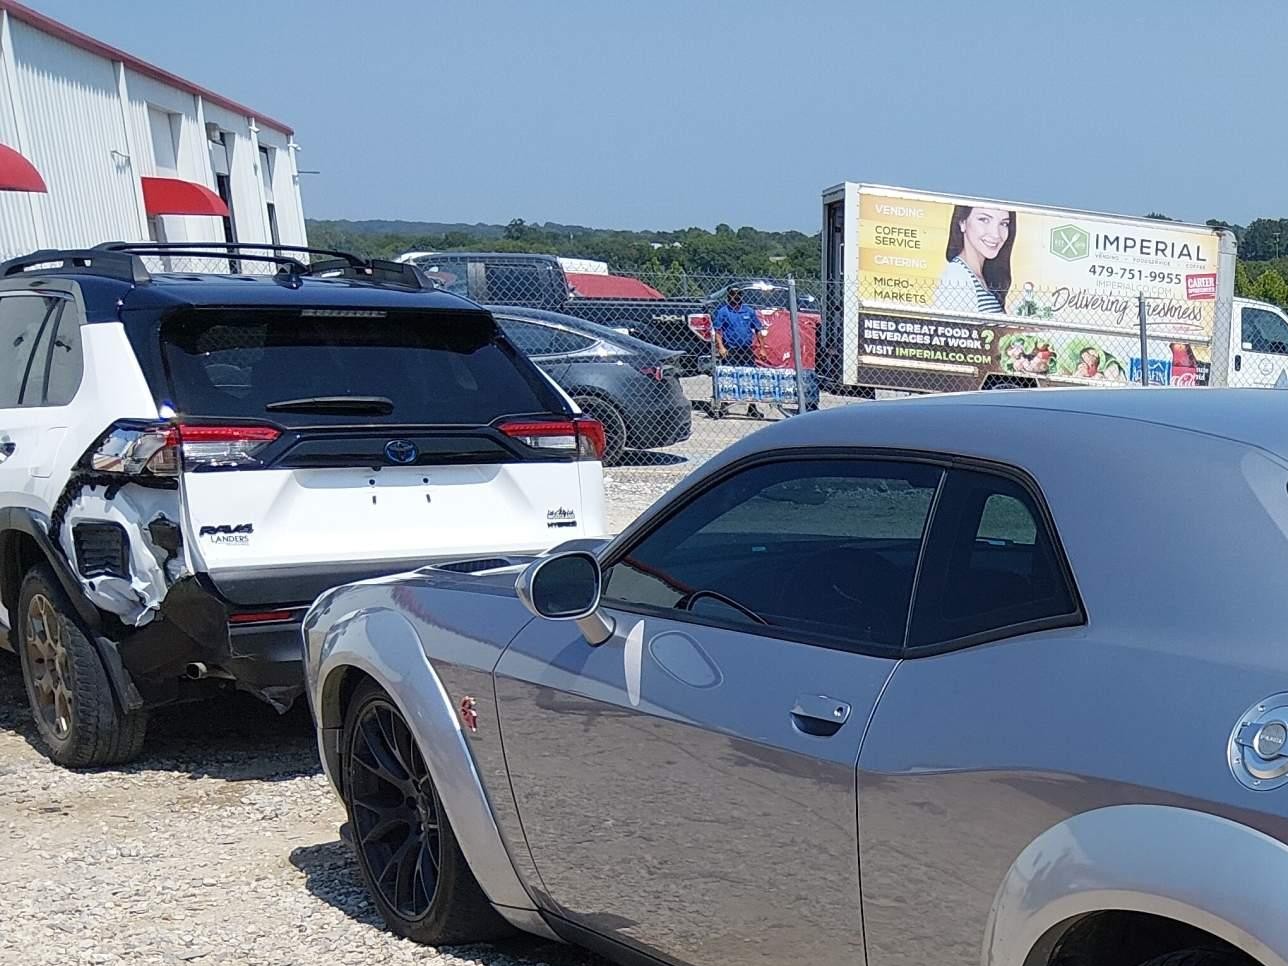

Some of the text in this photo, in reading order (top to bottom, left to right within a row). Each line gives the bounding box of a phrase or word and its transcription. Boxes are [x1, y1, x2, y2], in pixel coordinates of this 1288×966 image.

[874, 204, 924, 217] VENDING
[875, 226, 918, 238] COFFEE
[874, 236, 920, 250] SERVICE
[1096, 234, 1206, 262] IMPERIAL
[874, 254, 928, 268] CATERING
[874, 276, 914, 288] MICRO-
[1089, 264, 1182, 284] 479-751-9955
[874, 288, 926, 304] MARKETS
[1052, 288, 1128, 324] Delivering
[864, 320, 978, 339] NEED GREAT FOOD &
[864, 330, 930, 344] BEVERAGES
[932, 336, 946, 346] AT
[948, 338, 982, 350] WORK
[864, 344, 992, 364] VISIT IMPERIALCO.COM
[211, 535, 249, 544] LANDERS
